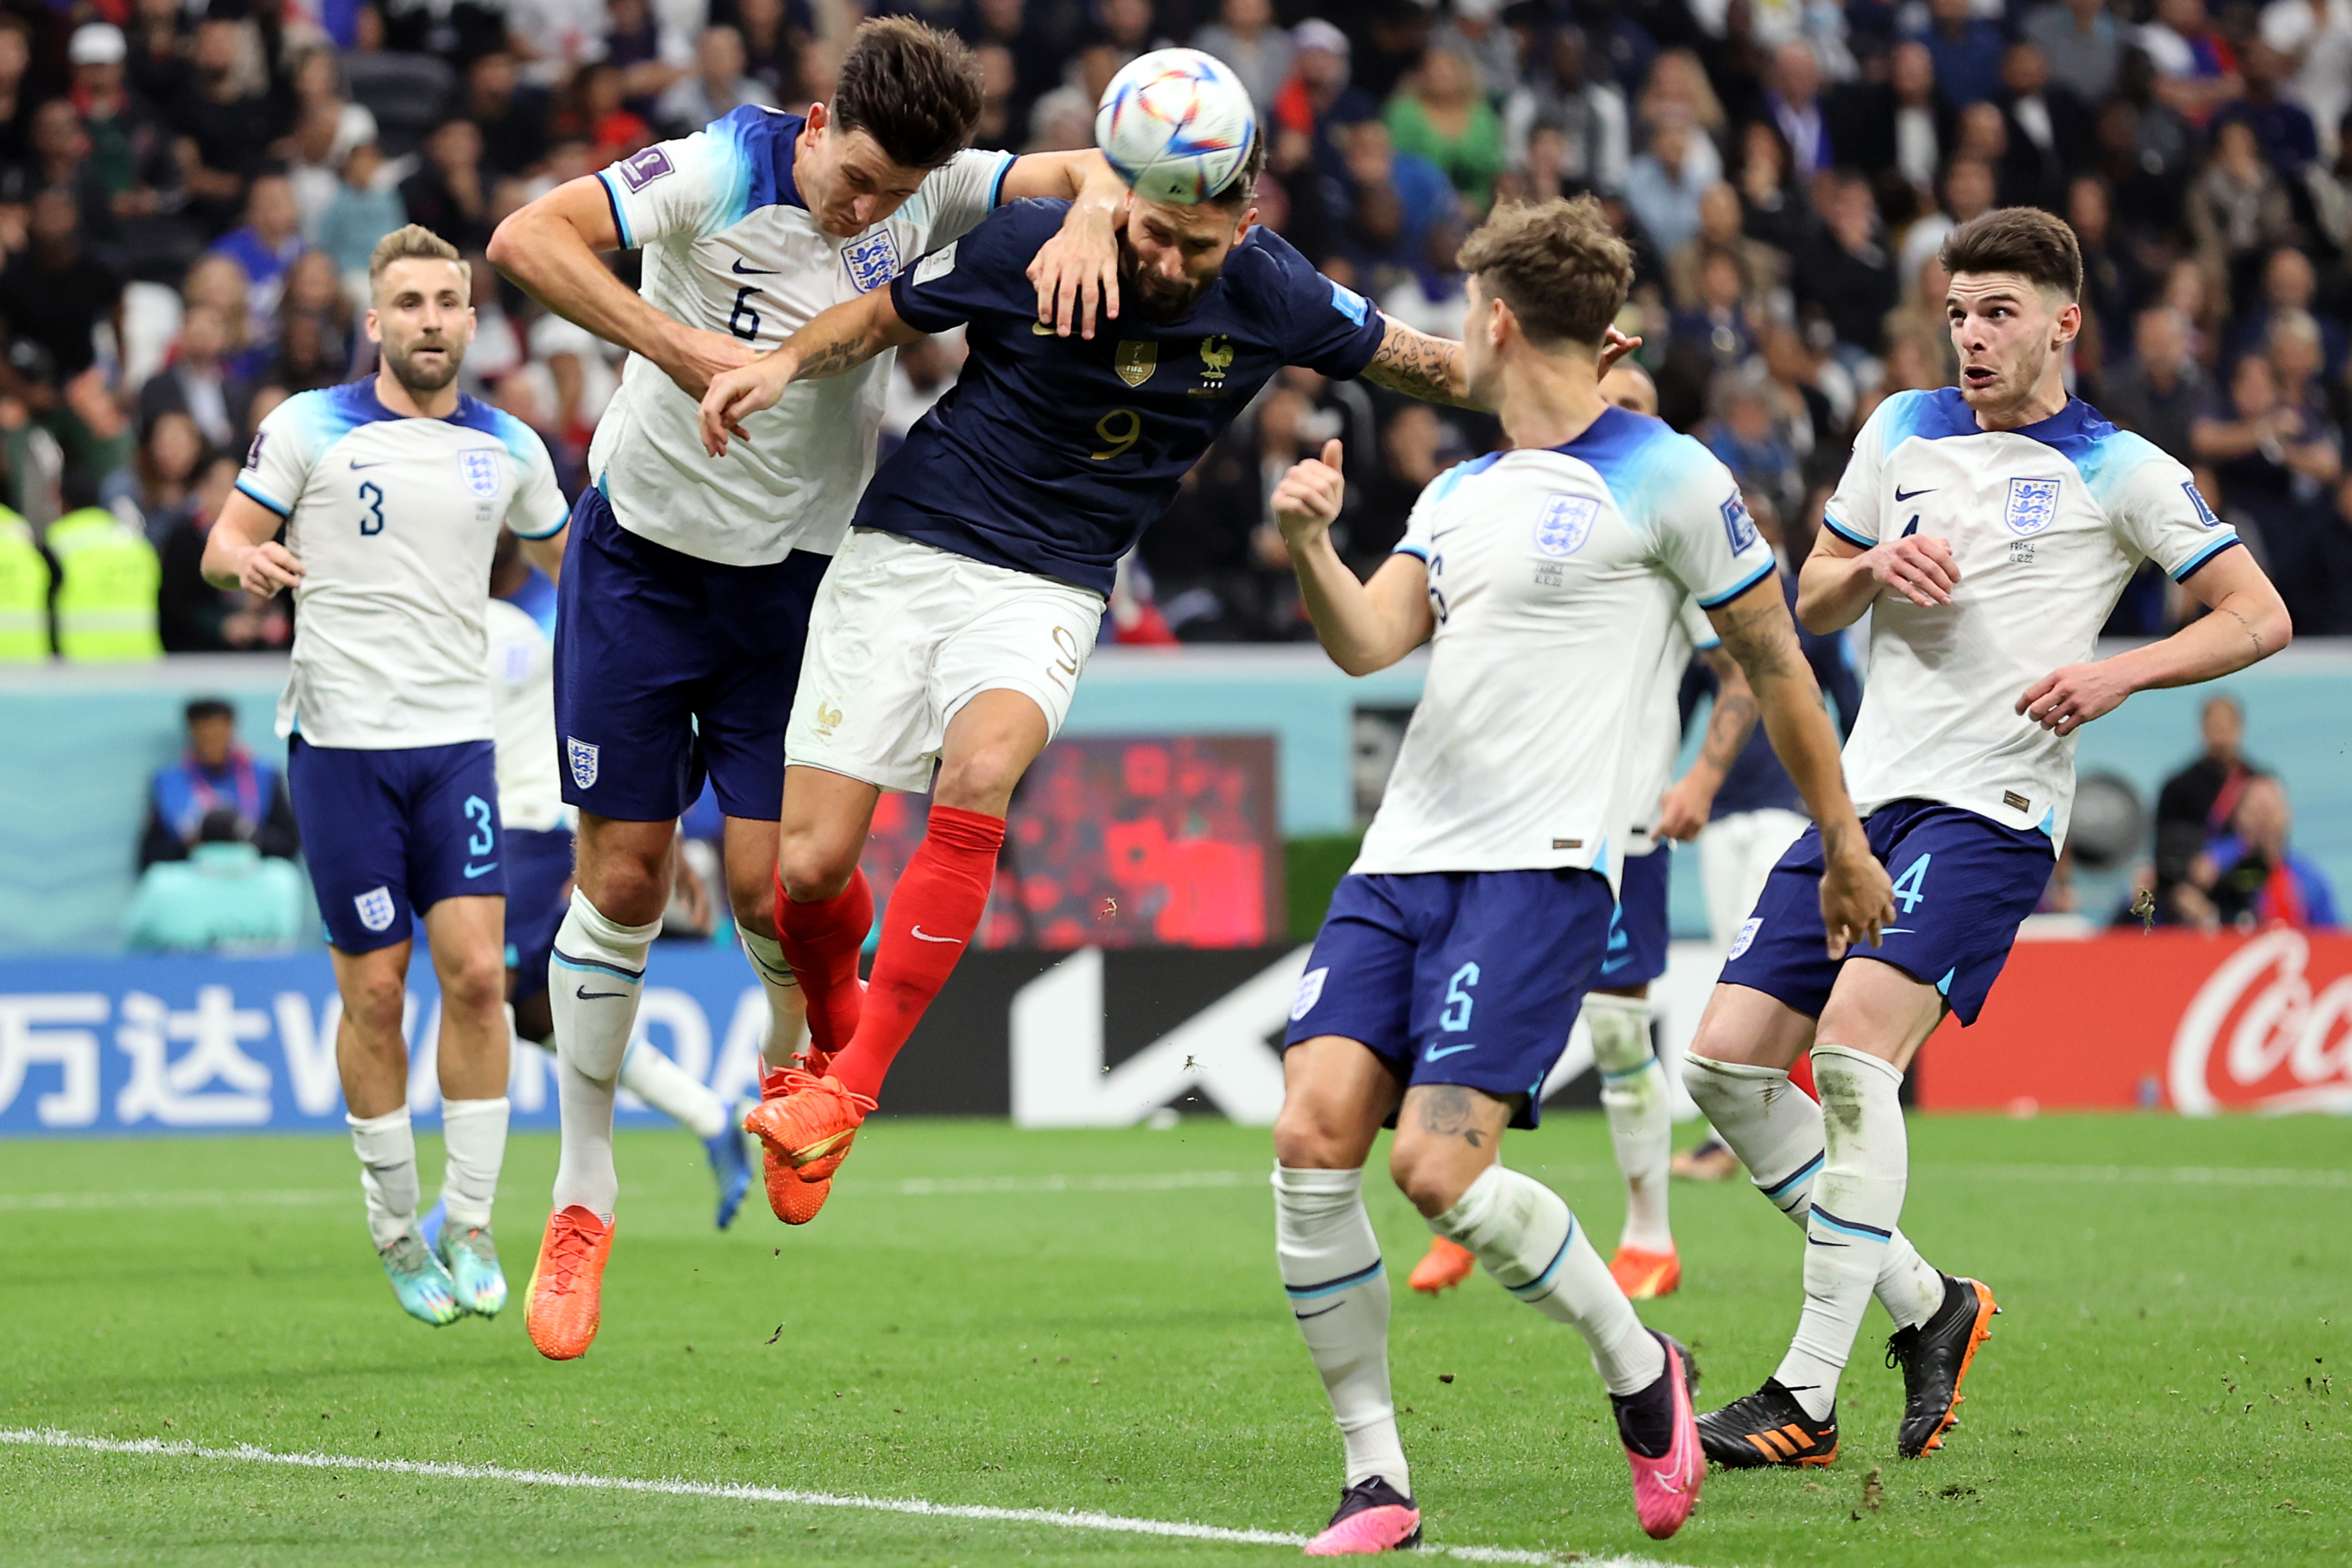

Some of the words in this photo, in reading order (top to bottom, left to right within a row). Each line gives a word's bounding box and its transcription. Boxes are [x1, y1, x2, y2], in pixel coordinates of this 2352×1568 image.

[730, 287, 763, 341] 6
[1091, 409, 1141, 460] 9
[359, 481, 384, 536] 3
[1052, 626, 1077, 676] 9
[464, 795, 494, 856] 3
[1891, 852, 1931, 914] 4
[1439, 961, 1481, 1032] 5
[2165, 926, 2352, 1121] Coc
[0, 987, 274, 1127] 万达
